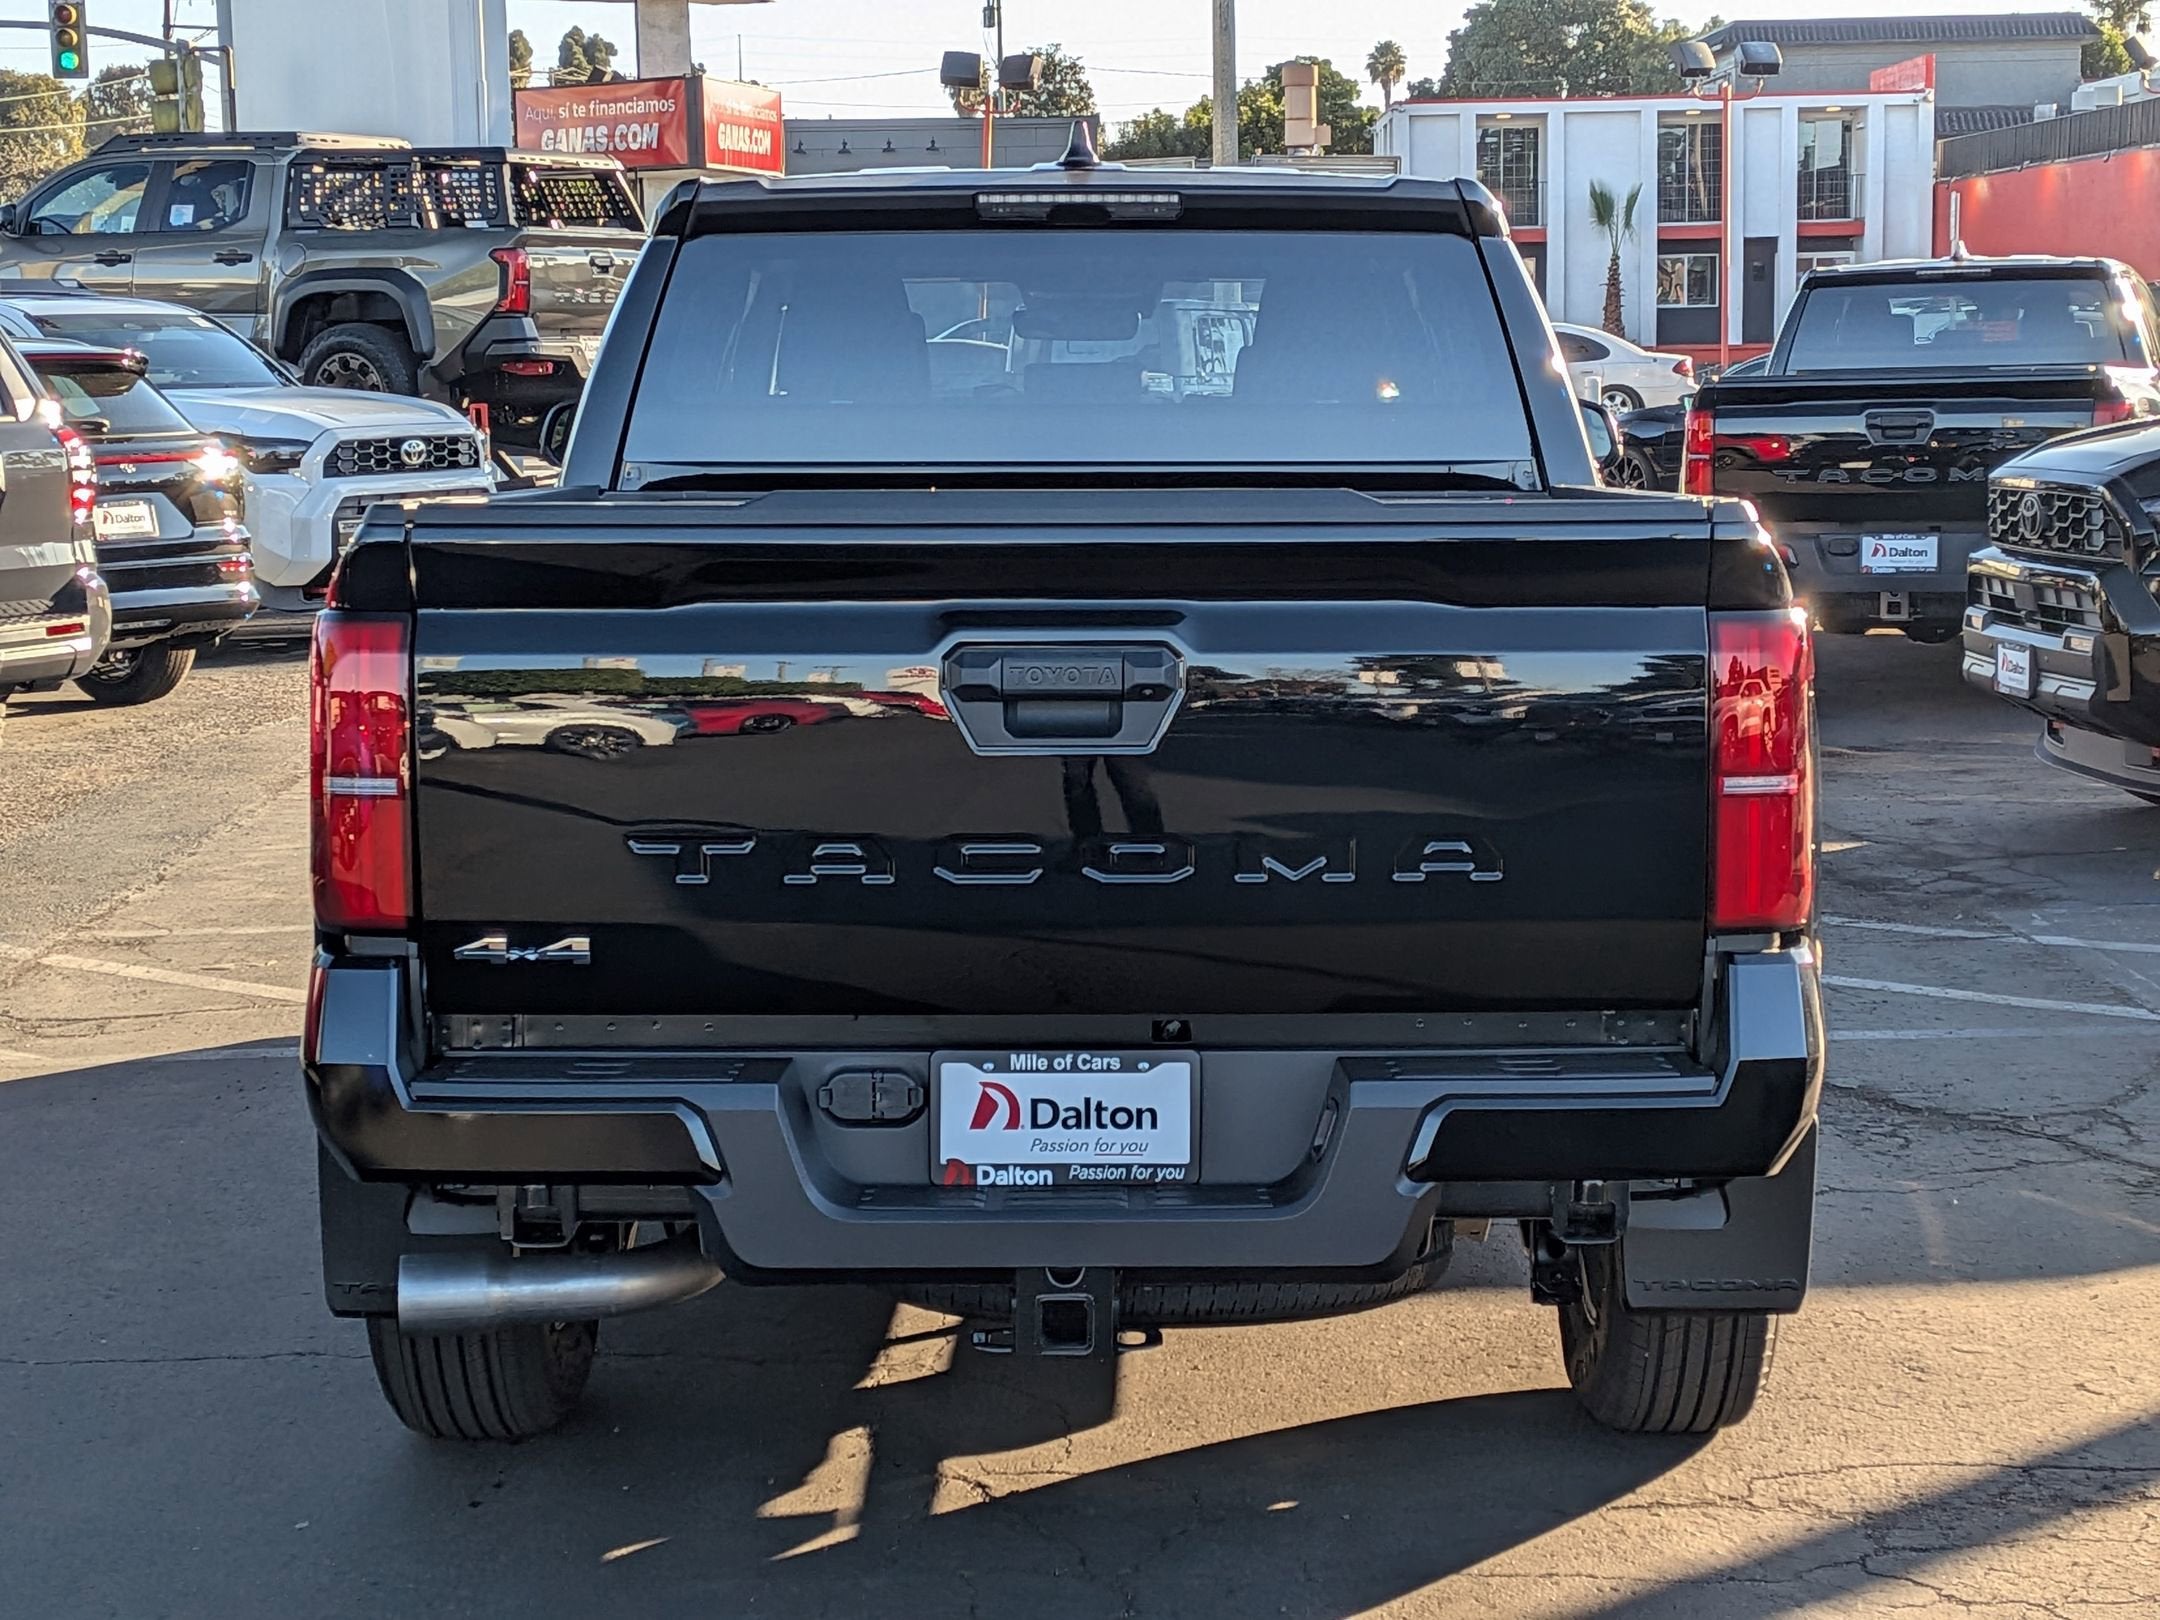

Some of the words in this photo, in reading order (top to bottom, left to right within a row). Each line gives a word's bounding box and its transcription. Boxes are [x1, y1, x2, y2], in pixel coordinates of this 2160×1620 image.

[558, 101, 570, 119] sí
[572, 103, 586, 118] te
[589, 97, 676, 117] financiamos
[541, 122, 660, 153] GANAS.COM
[717, 122, 772, 157] GANAS.COM
[1772, 467, 1985, 484] TACOM
[1888, 547, 1928, 558] Dalton
[1009, 666, 1116, 686] TOYOTA
[624, 831, 1504, 885] TACOMA
[453, 937, 591, 964] 4x4
[1010, 1053, 1050, 1071] Mile
[1053, 1053, 1073, 1071] of
[1076, 1053, 1121, 1071] Cars
[1030, 1096, 1158, 1131] Dalton
[1029, 1138, 1088, 1153] Passion
[1093, 1137, 1114, 1153] for
[1119, 1141, 1149, 1155] you
[976, 1165, 1054, 1186] Dalton
[1068, 1164, 1127, 1181] Passion
[1130, 1164, 1153, 1180] for
[1154, 1166, 1185, 1182] you
